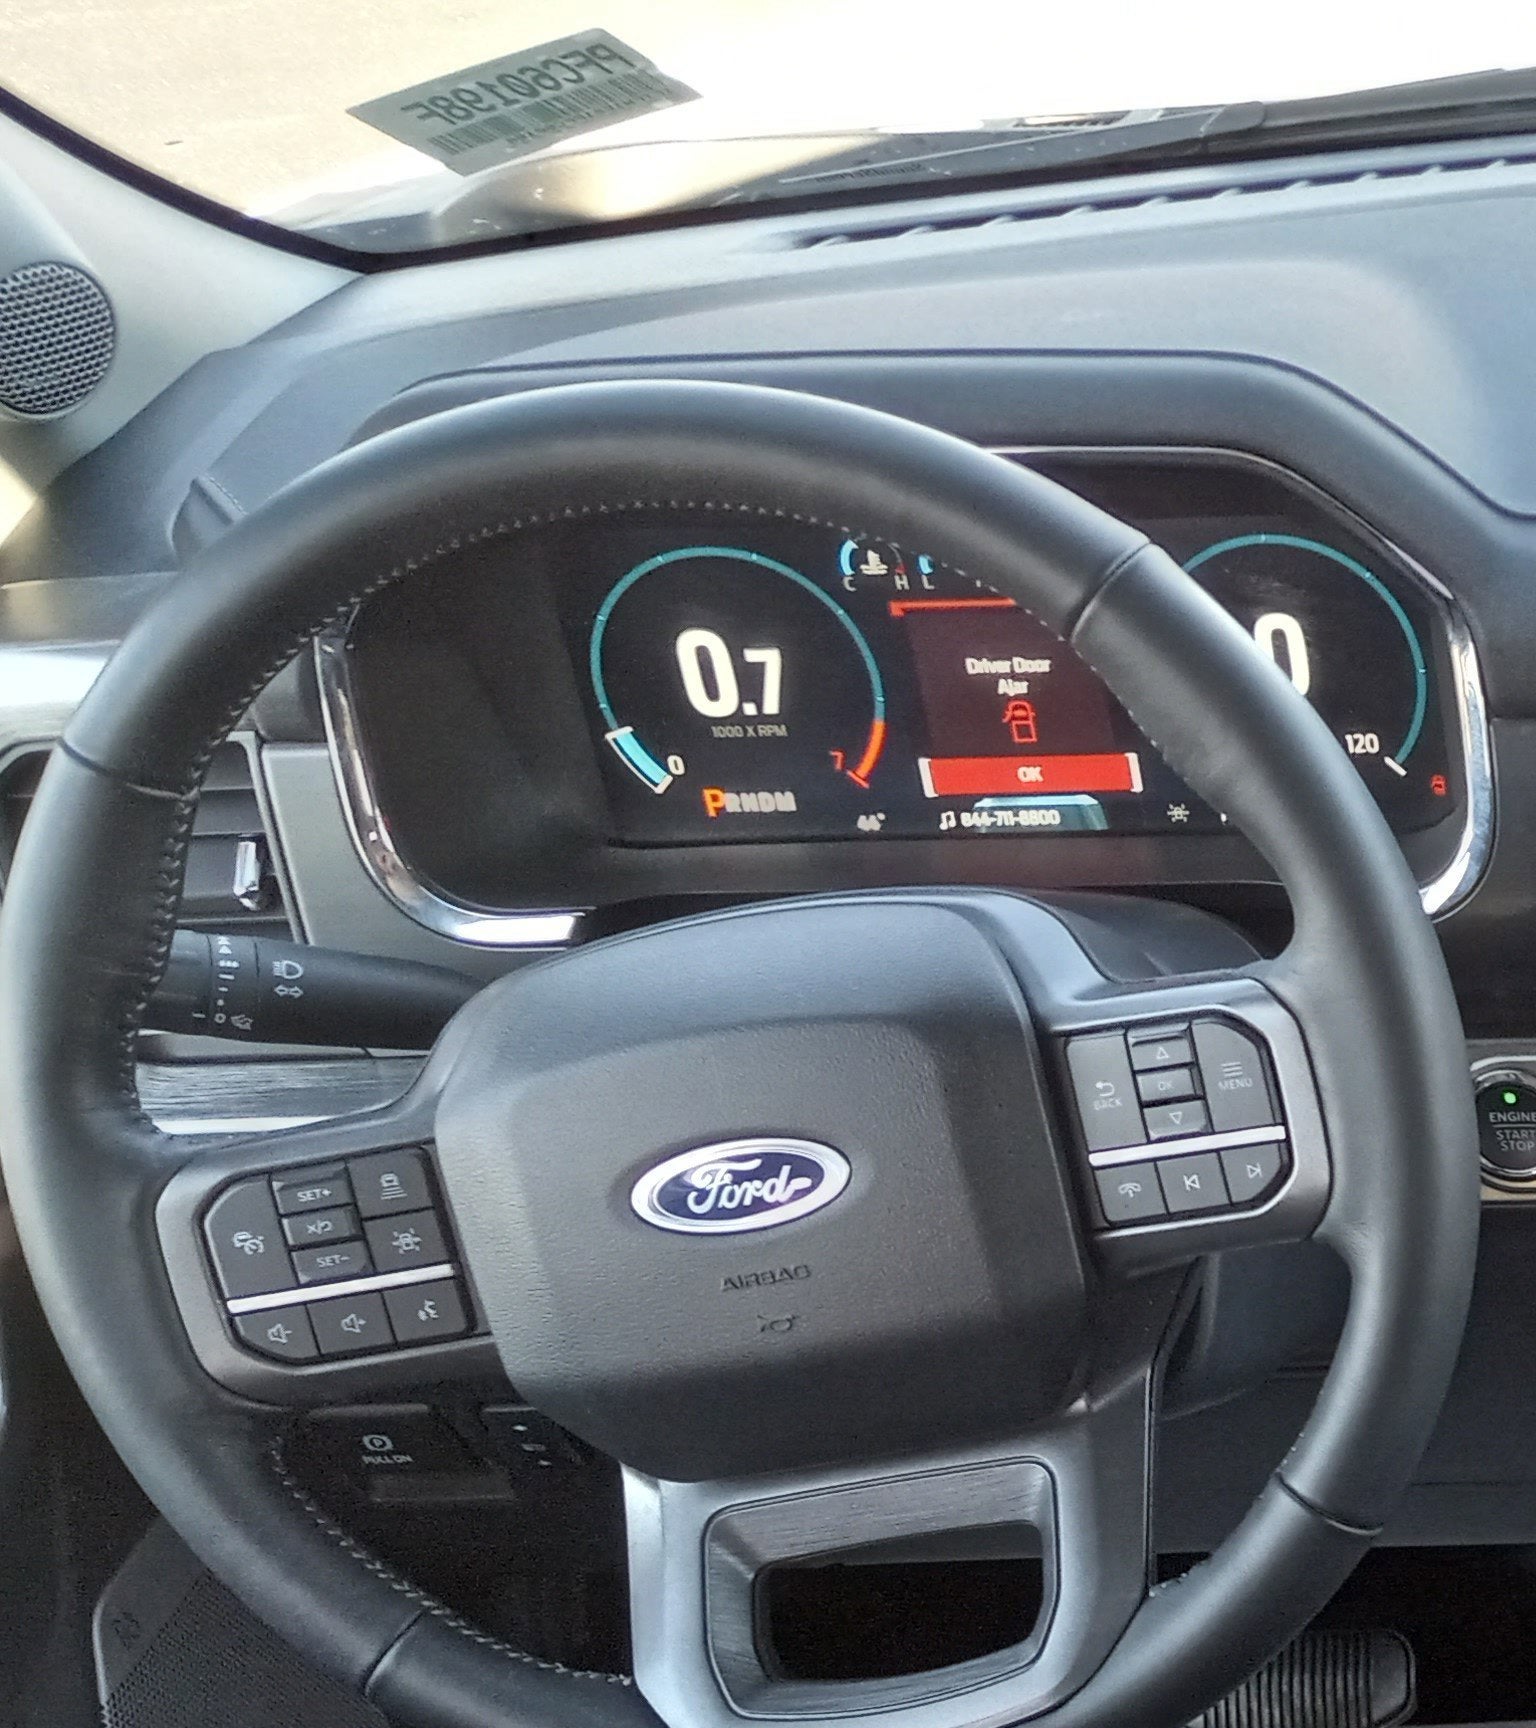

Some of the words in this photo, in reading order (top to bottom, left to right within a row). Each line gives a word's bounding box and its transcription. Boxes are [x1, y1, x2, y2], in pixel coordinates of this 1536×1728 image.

[843, 576, 856, 592] C
[894, 574, 910, 590] H
[676, 628, 781, 717] 0.7
[965, 658, 1011, 674] Driver
[1013, 657, 1051, 673] Door
[998, 679, 1028, 696] Ajar
[712, 726, 744, 738] 1000
[758, 724, 788, 737] RPM
[1345, 734, 1379, 754] 120
[667, 754, 685, 776] 0
[1017, 766, 1043, 782] OK
[1218, 1078, 1253, 1091] MENU
[1496, 1129, 1536, 1140] START
[1500, 1141, 1535, 1151] STOP
[687, 1158, 812, 1214] Ford
[720, 1264, 811, 1292] AIRBAG
